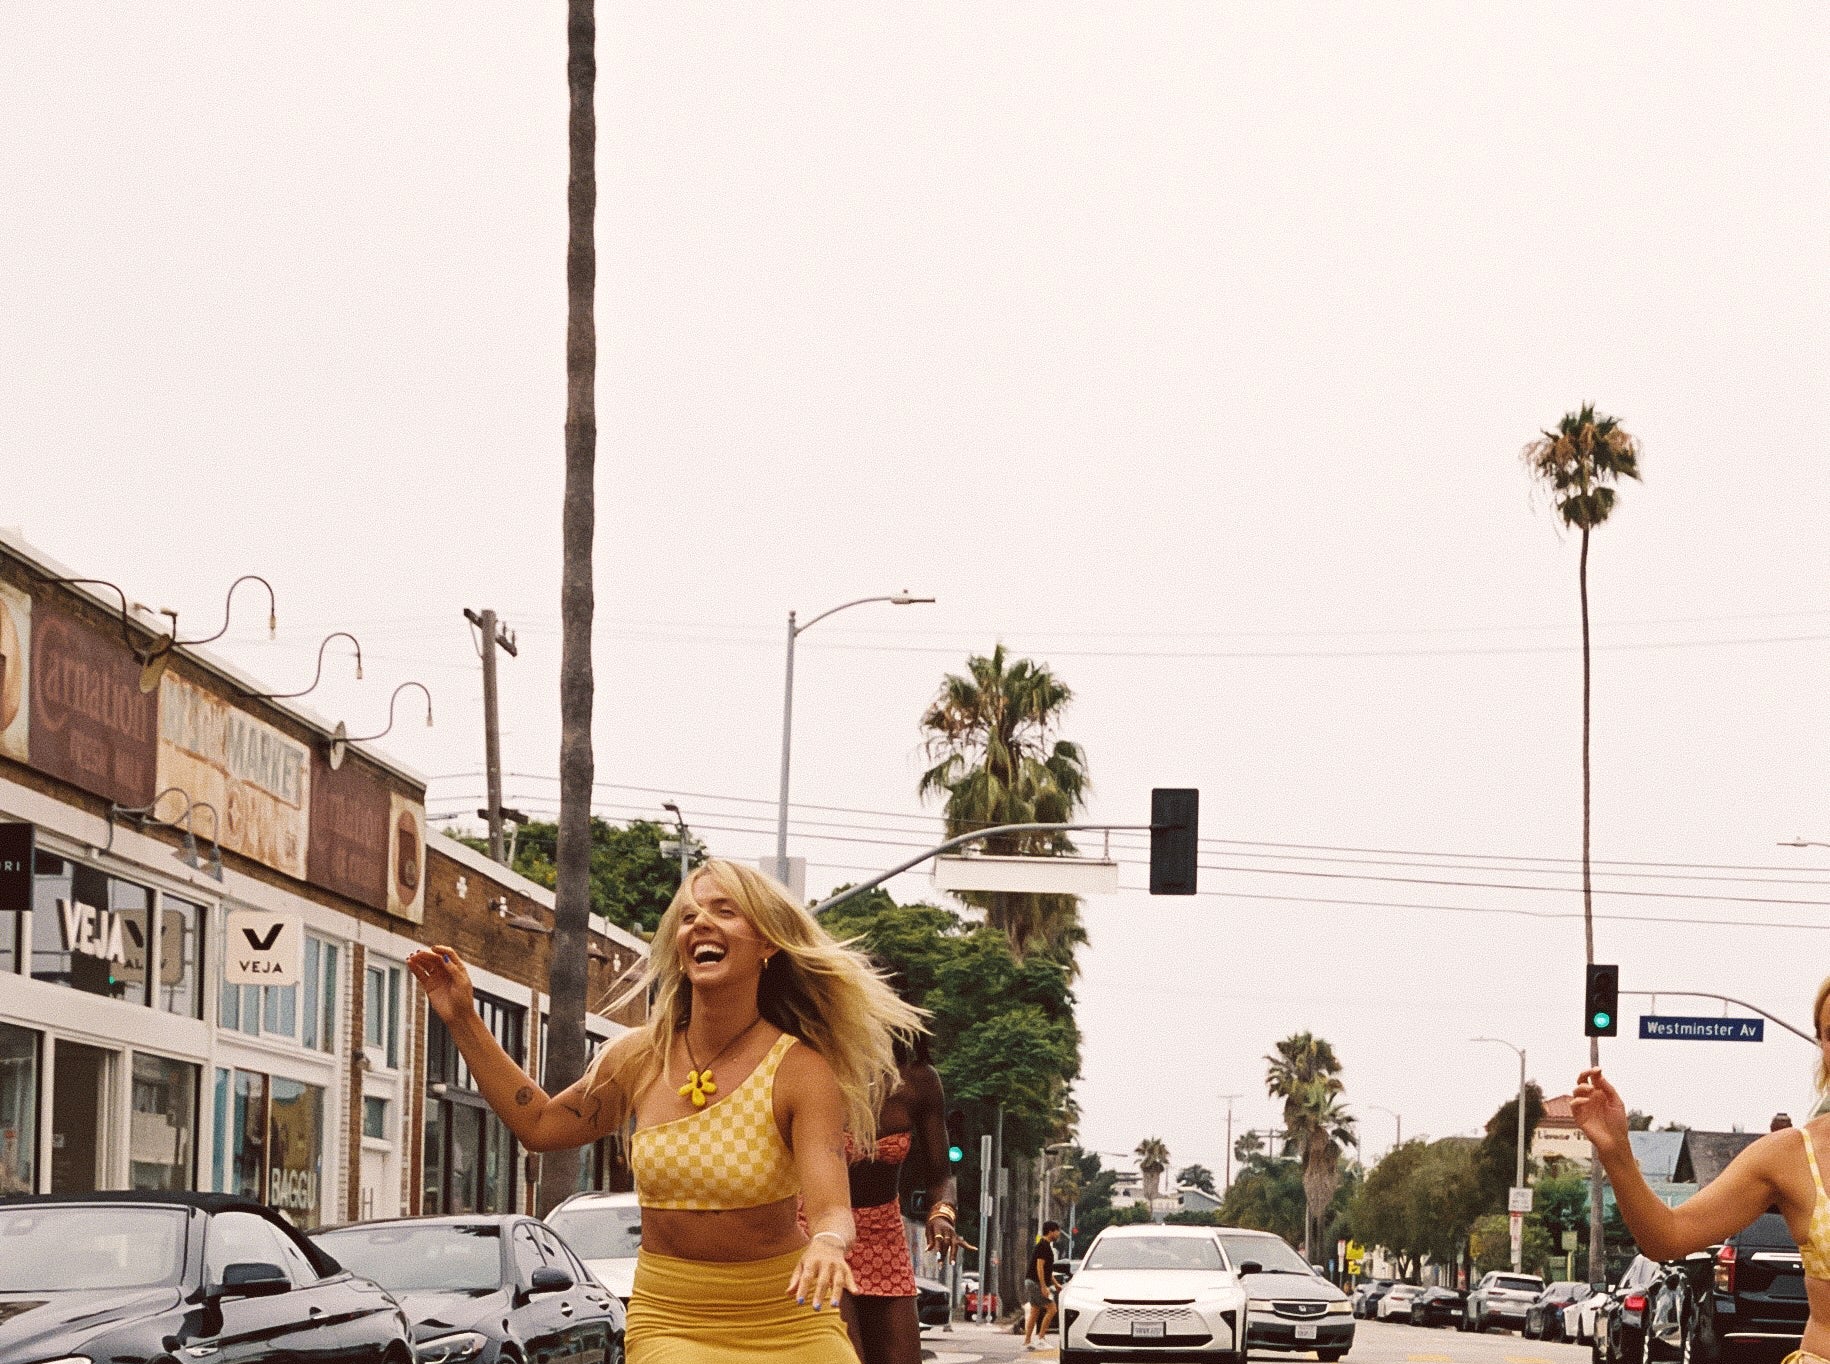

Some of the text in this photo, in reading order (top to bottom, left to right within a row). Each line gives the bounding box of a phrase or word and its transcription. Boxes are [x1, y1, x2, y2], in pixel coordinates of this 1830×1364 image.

[227, 711, 305, 804] MARKET
[0, 860, 21, 872] RI
[60, 899, 126, 965] VEJA
[239, 960, 284, 974] VEJA
[1647, 1021, 1757, 1037] Westminster Av
[271, 1167, 317, 1210] BAGGU
